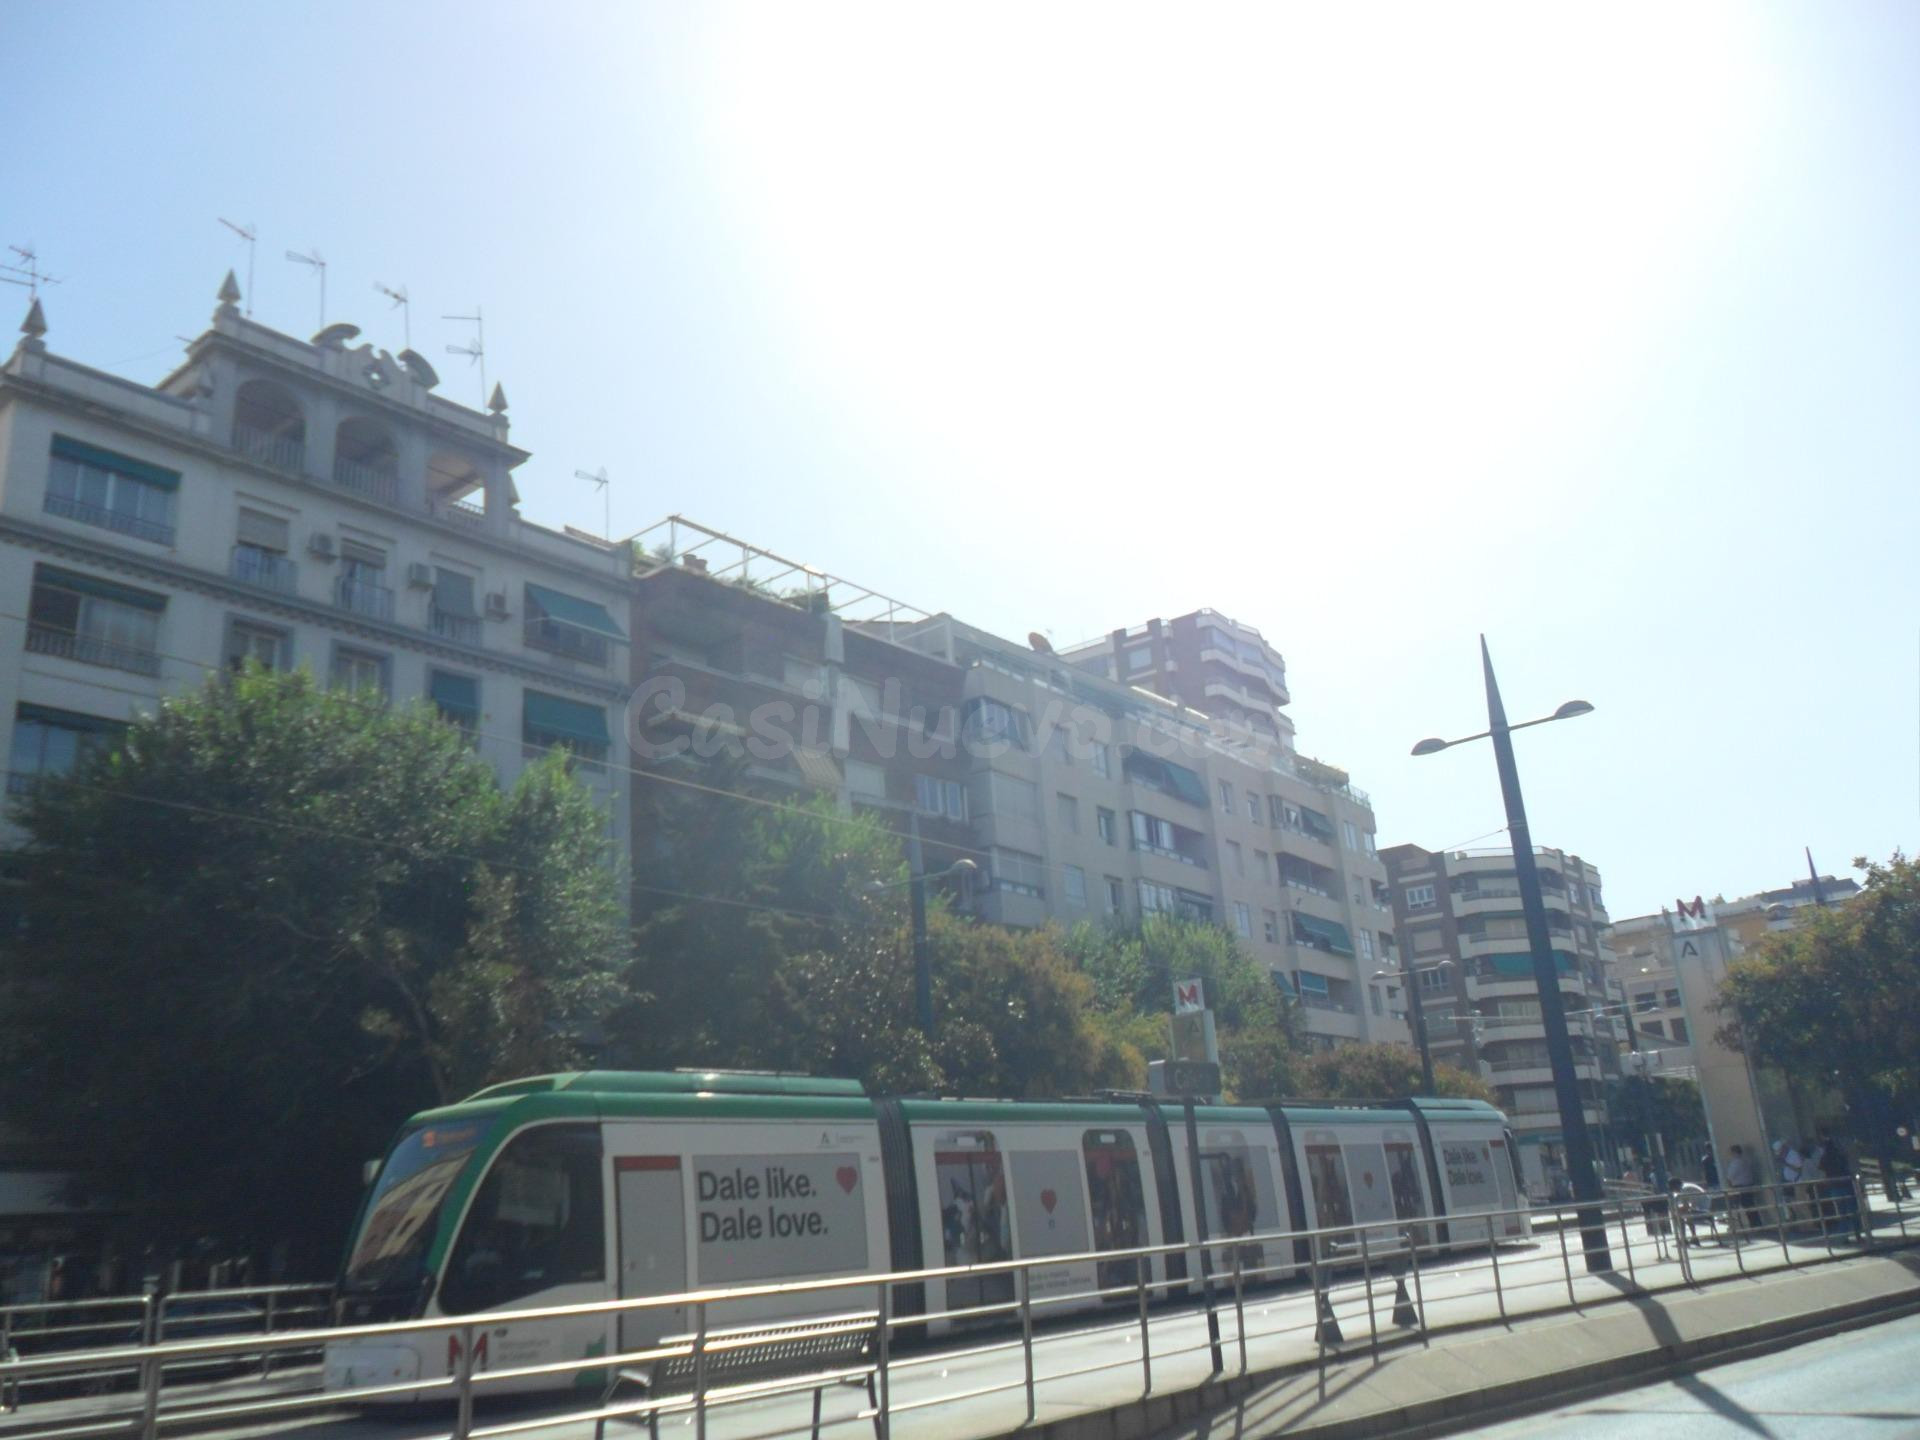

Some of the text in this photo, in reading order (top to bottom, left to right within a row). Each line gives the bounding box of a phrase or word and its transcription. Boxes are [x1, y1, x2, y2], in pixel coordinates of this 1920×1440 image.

[1676, 895, 1707, 922] M
[698, 1166, 817, 1202] Dale like.
[700, 1205, 829, 1243] Dale love.
